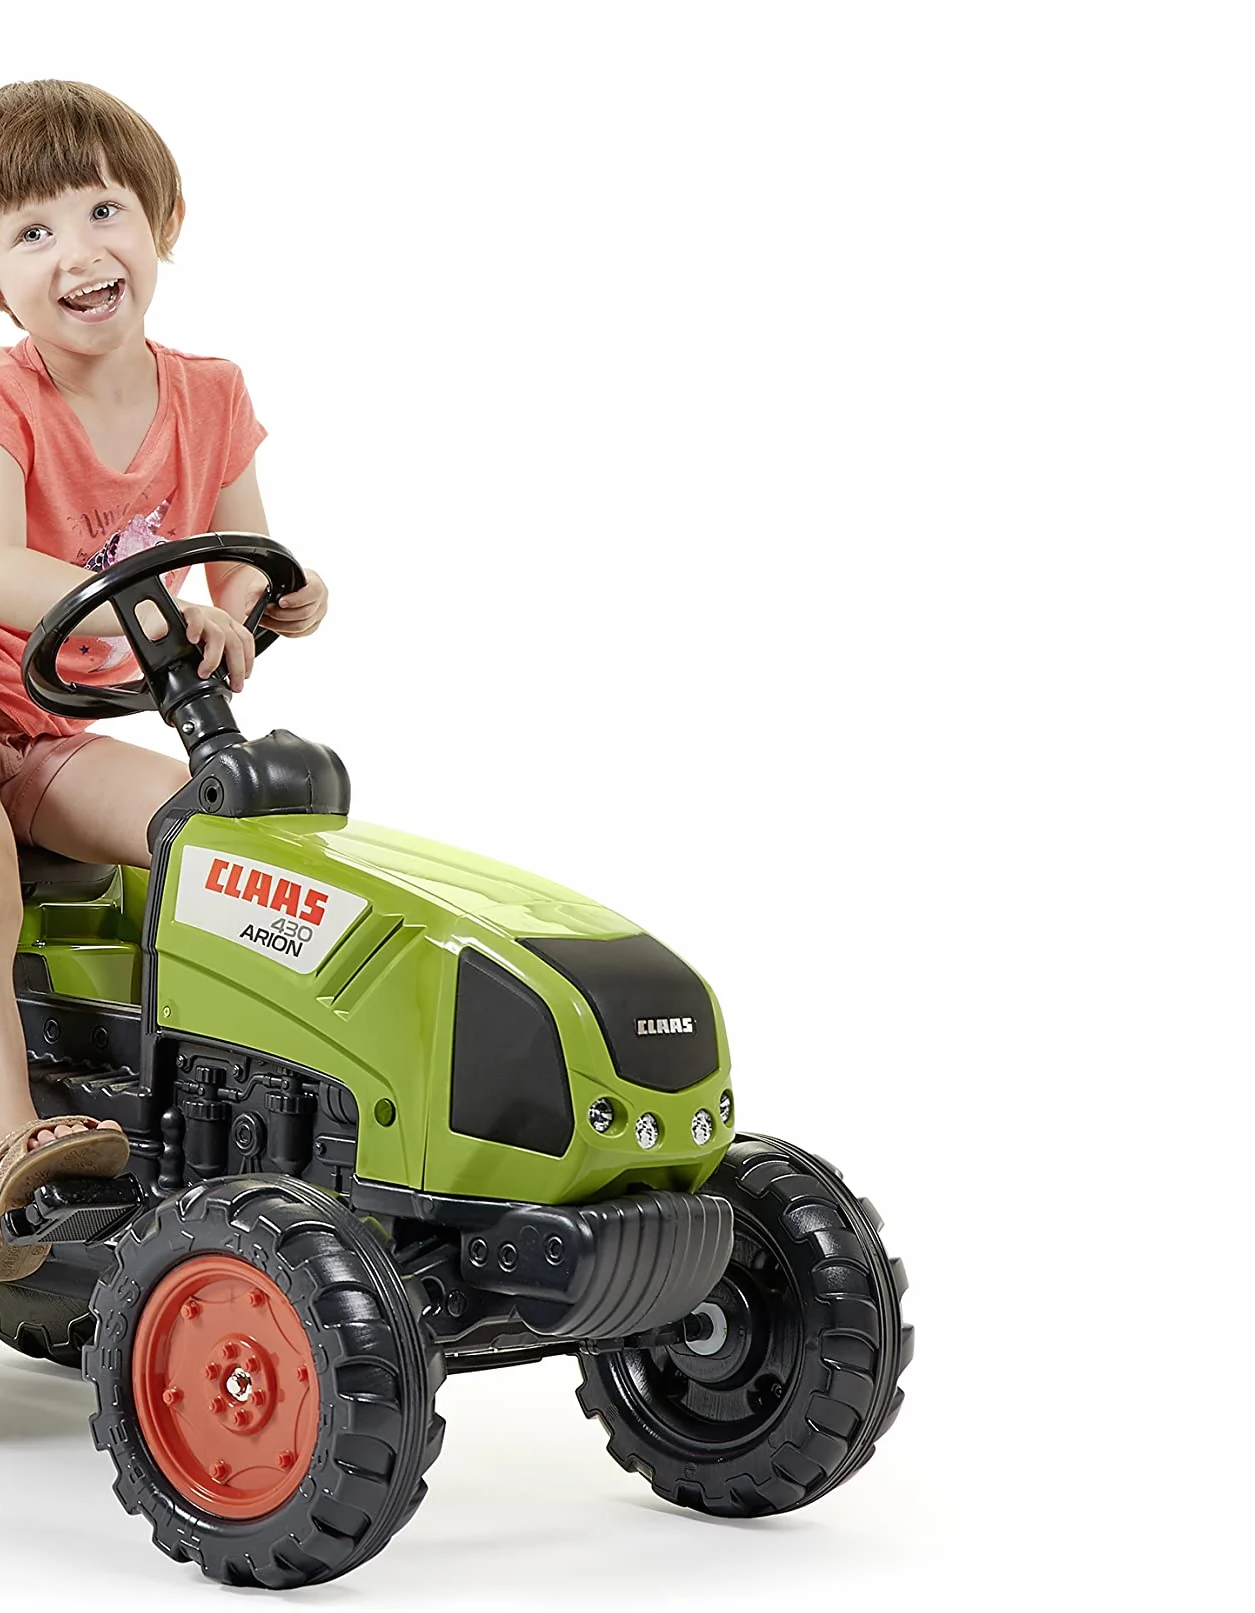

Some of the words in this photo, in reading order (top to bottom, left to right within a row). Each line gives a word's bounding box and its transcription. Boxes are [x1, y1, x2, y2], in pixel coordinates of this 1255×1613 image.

[206, 859, 329, 926] CLAAS
[239, 924, 304, 958] ARION
[270, 917, 313, 943] 430
[637, 1017, 693, 1035] CLAAS
